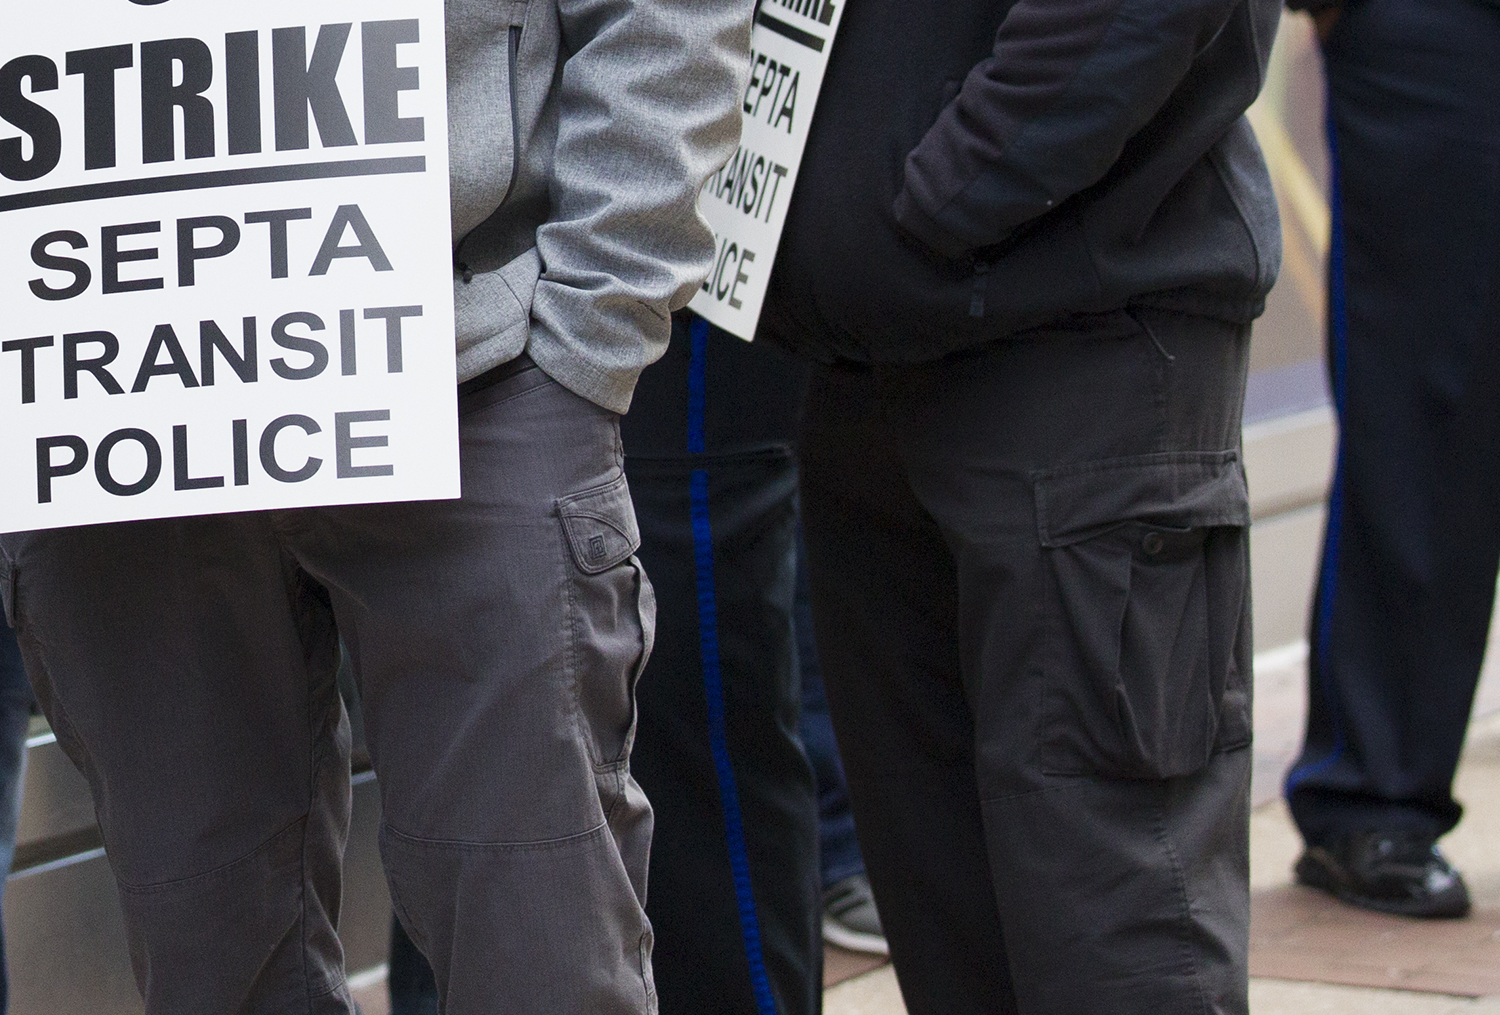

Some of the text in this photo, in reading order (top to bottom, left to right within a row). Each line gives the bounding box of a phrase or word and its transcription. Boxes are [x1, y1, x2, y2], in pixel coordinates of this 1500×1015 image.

[742, 48, 800, 134] EPTA
[28, 204, 394, 301] SEPTA
[2, 305, 423, 405] TRANSIT
[36, 409, 393, 504] POLICE
